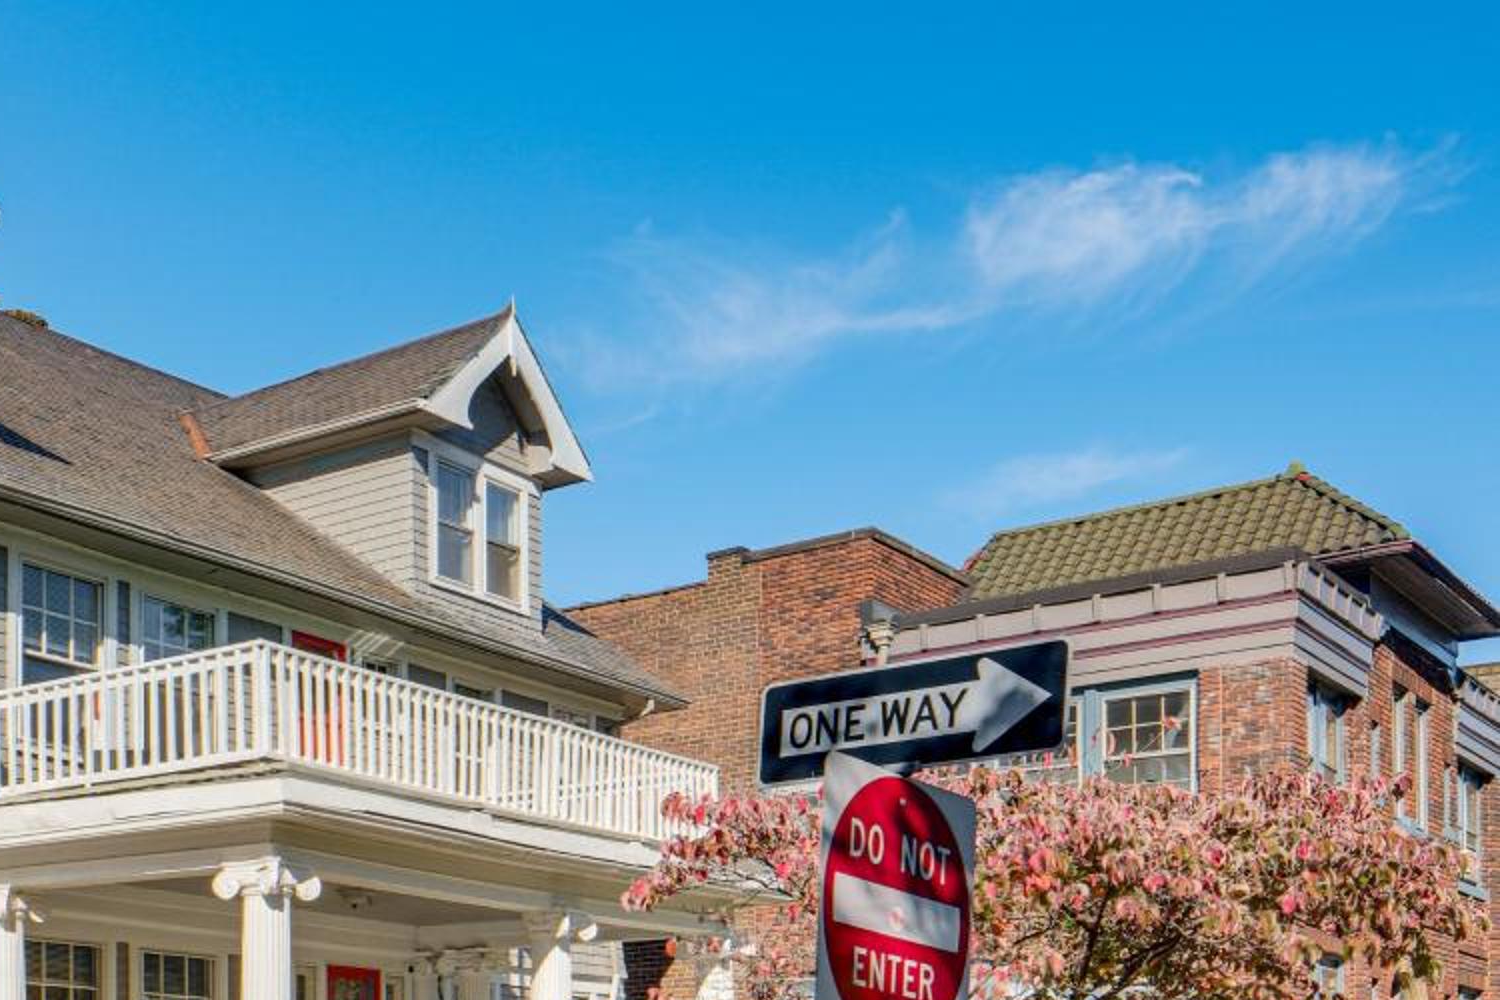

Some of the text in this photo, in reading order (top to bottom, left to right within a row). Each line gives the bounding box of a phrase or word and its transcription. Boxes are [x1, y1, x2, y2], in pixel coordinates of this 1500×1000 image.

[789, 688, 968, 749] ONE WAY
[849, 817, 951, 886] DO NOT
